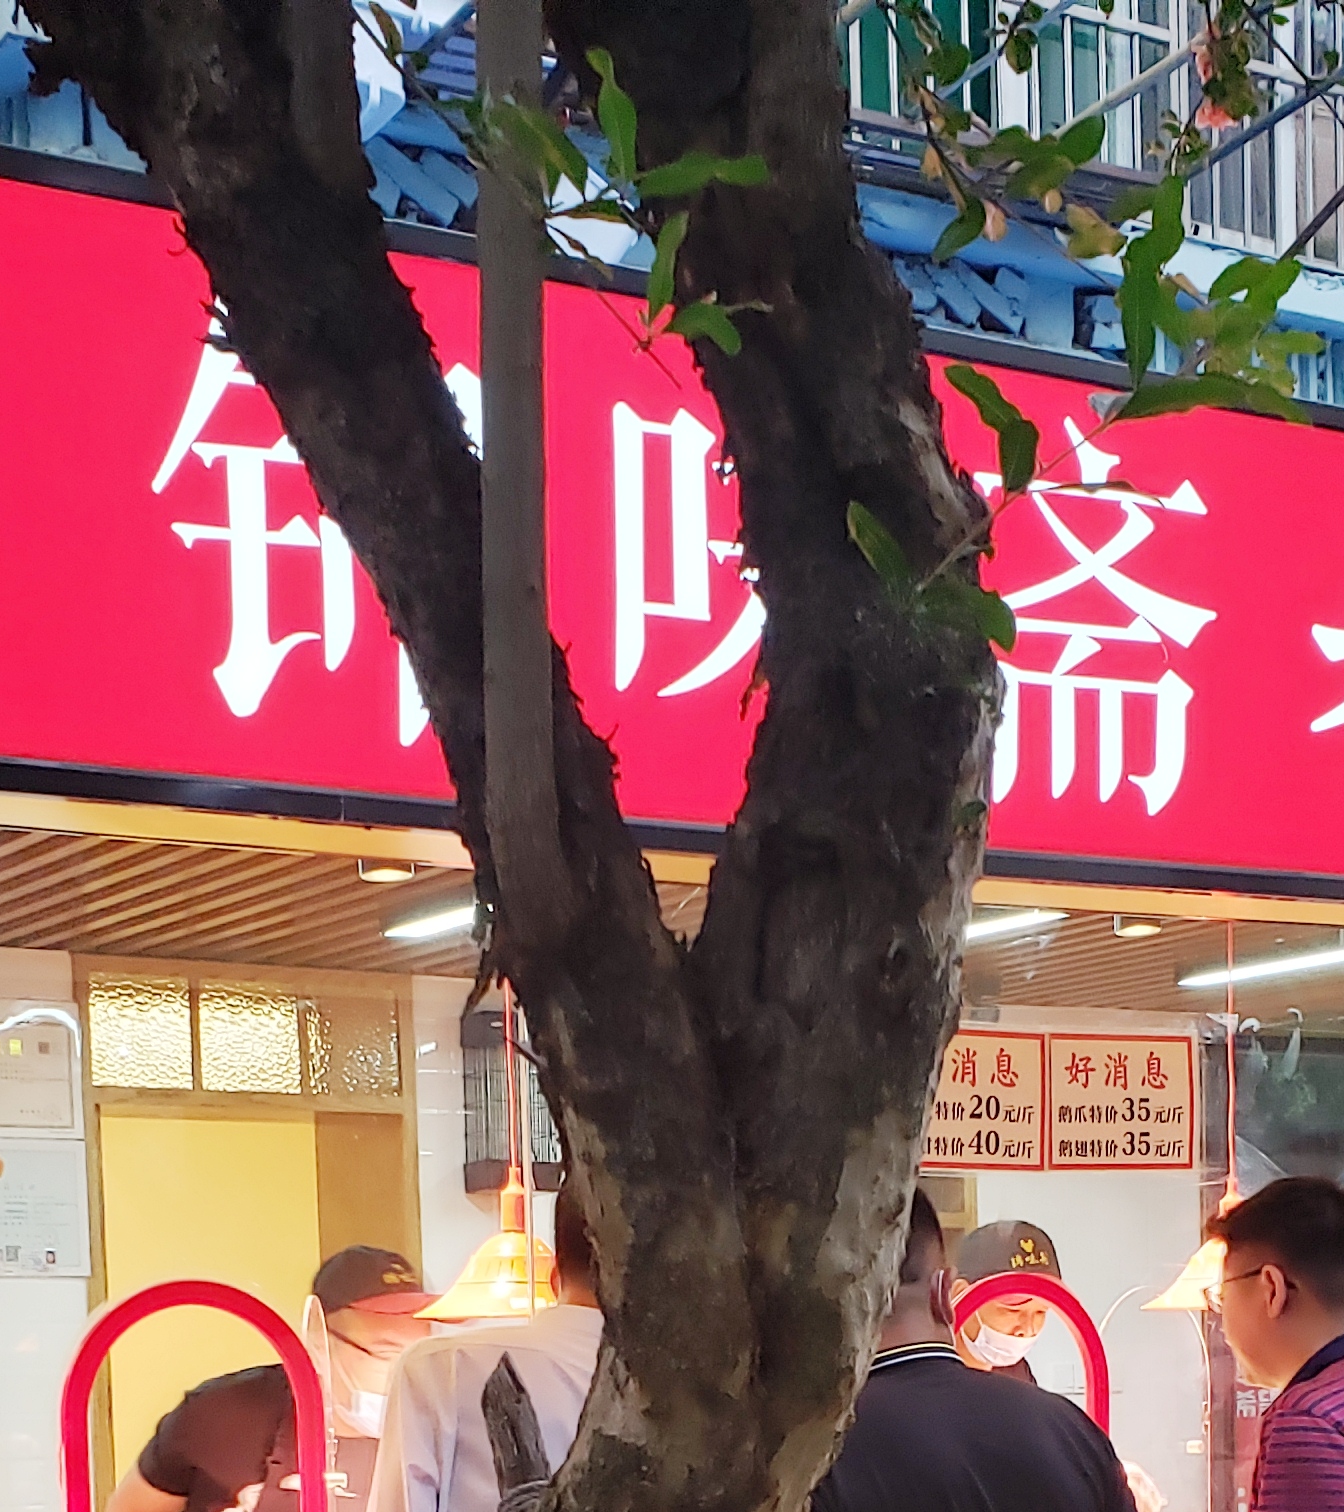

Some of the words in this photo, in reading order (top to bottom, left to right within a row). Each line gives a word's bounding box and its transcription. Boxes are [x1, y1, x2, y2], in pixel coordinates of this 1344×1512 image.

[951, 1047, 1019, 1088] 消息
[1064, 1050, 1169, 1091] 好消息
[927, 1130, 1035, 1158] 特价40元/斤
